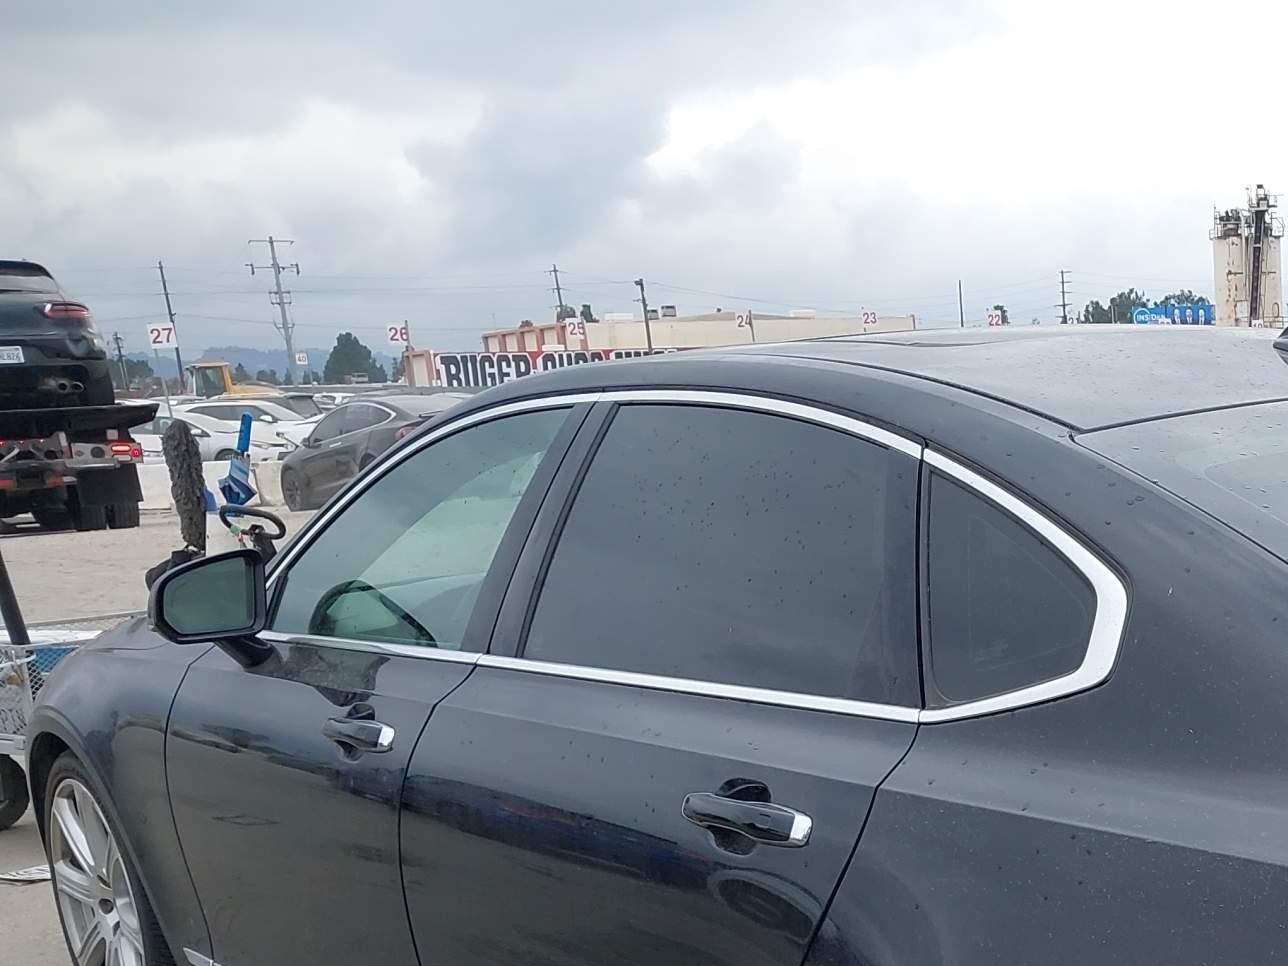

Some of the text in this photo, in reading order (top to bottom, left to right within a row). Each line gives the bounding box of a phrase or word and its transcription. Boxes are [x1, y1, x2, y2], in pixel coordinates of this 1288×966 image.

[736, 314, 752, 328] 24
[862, 311, 878, 324] 23
[987, 314, 1001, 326] 22
[388, 327, 409, 342] 26
[567, 322, 585, 335] 25
[150, 328, 173, 344] 27
